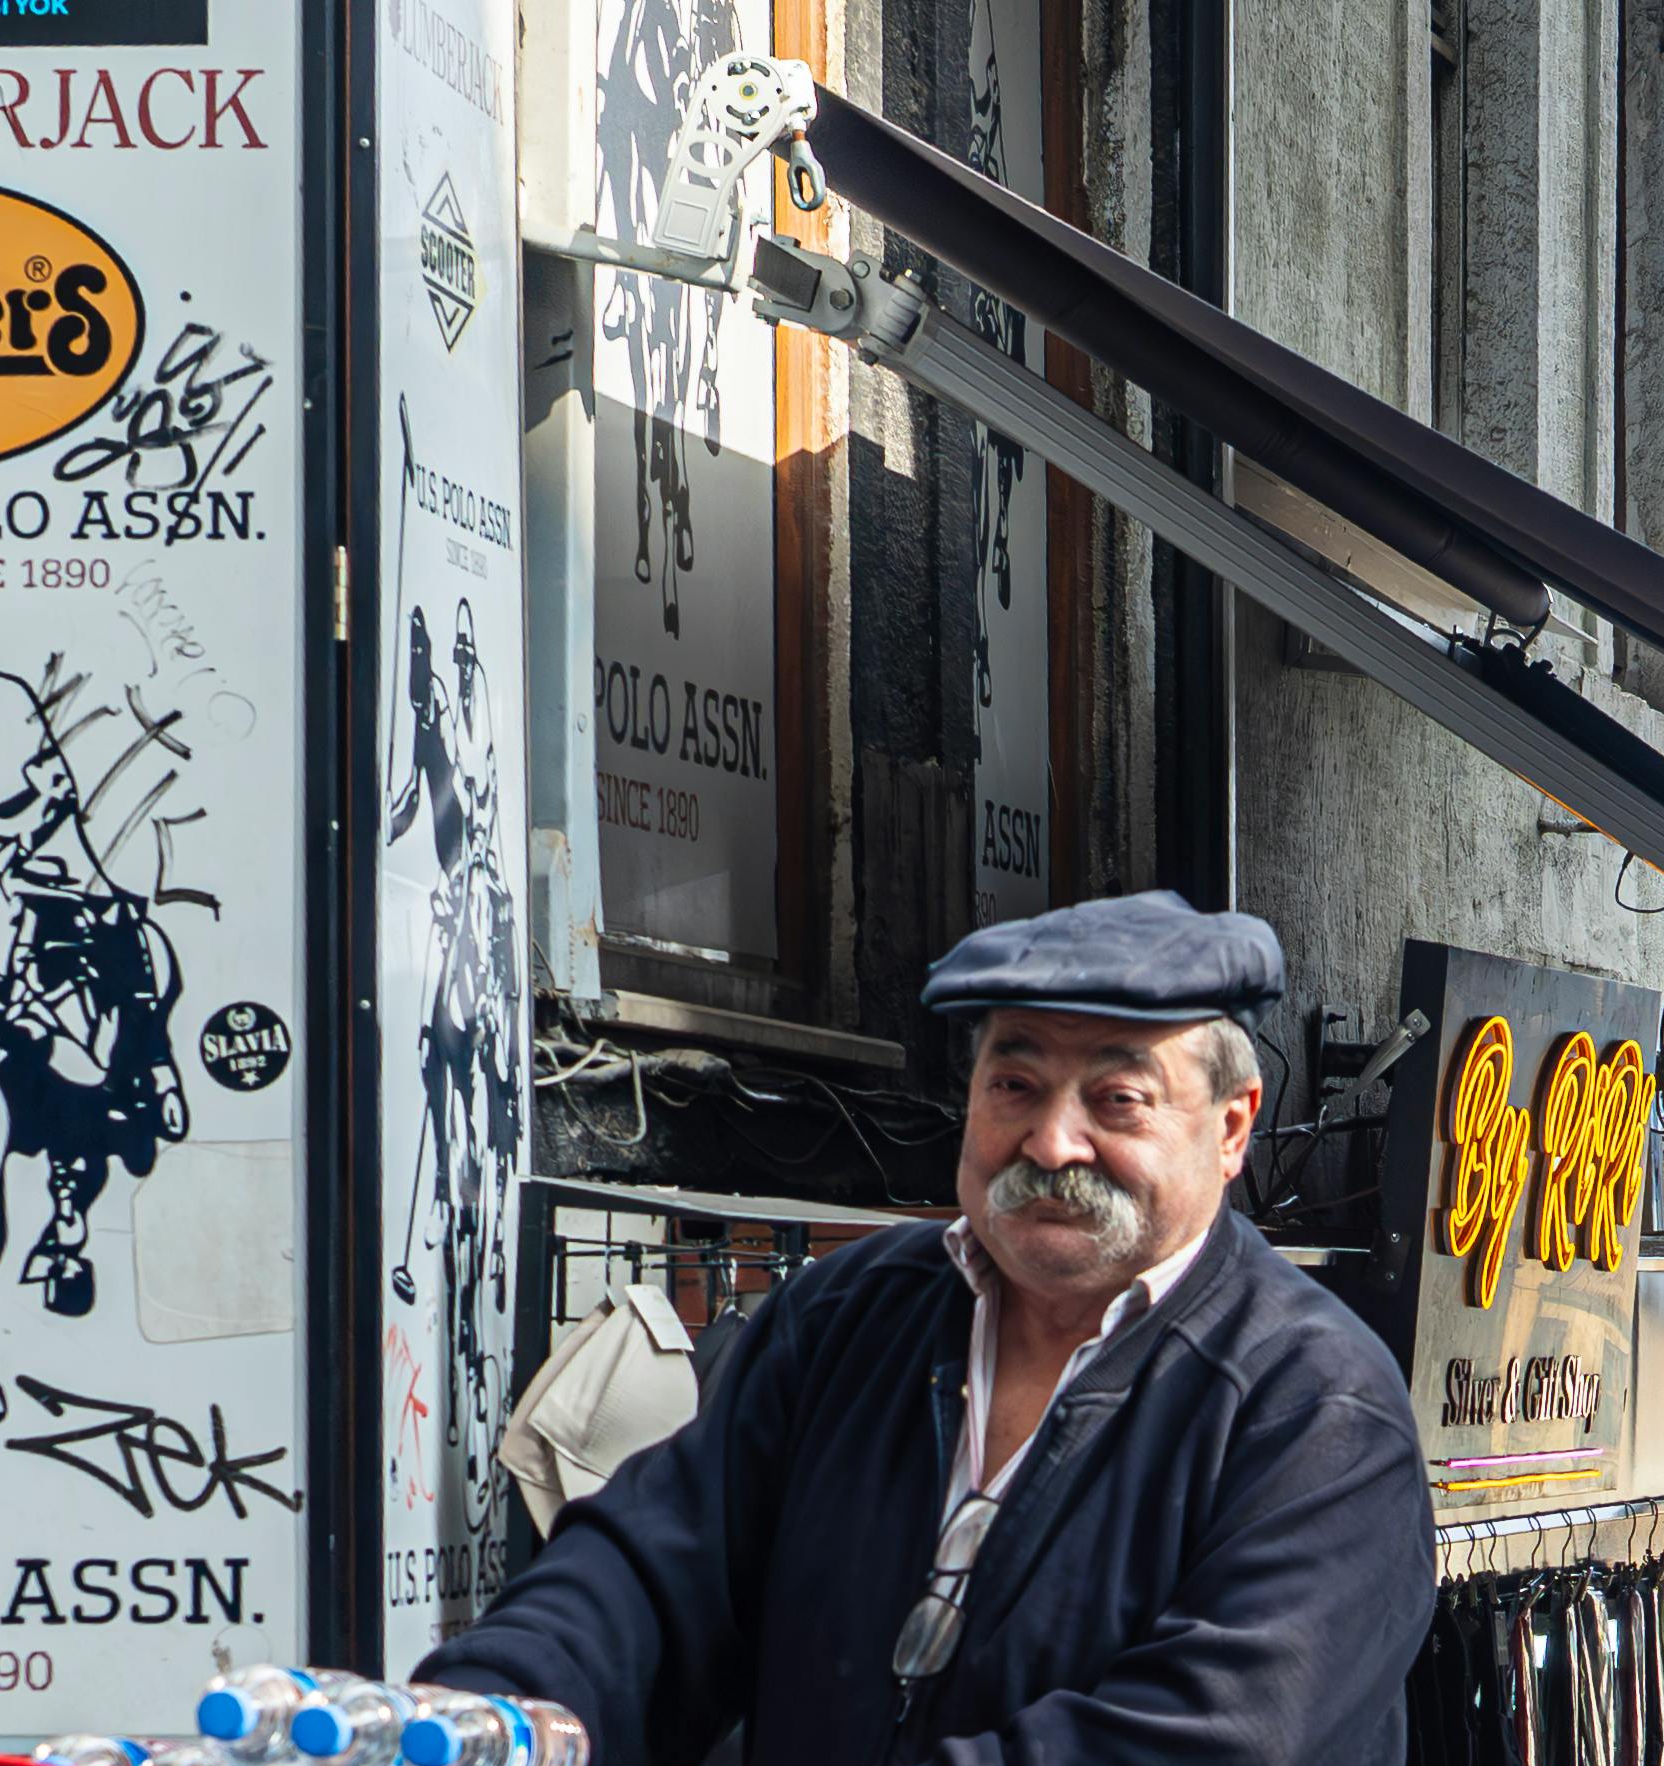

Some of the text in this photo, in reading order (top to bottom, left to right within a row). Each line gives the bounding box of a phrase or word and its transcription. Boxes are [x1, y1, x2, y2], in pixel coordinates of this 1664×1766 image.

[14, 0, 69, 16] YOK
[420, 224, 476, 300] SCOOTER
[70, 490, 266, 546] ASSN.
[415, 463, 439, 516] U.S.
[441, 476, 476, 532] POLO
[21, 557, 111, 590] 1890
[679, 681, 768, 781] ASSN.
[657, 787, 700, 842] 1890
[203, 1023, 288, 1063] SLAVIA
[1441, 1357, 1501, 1428] Silver
[1501, 1357, 1521, 1424] &
[0, 1558, 265, 1625] ASSN.
[423, 1544, 472, 1603] POLO
